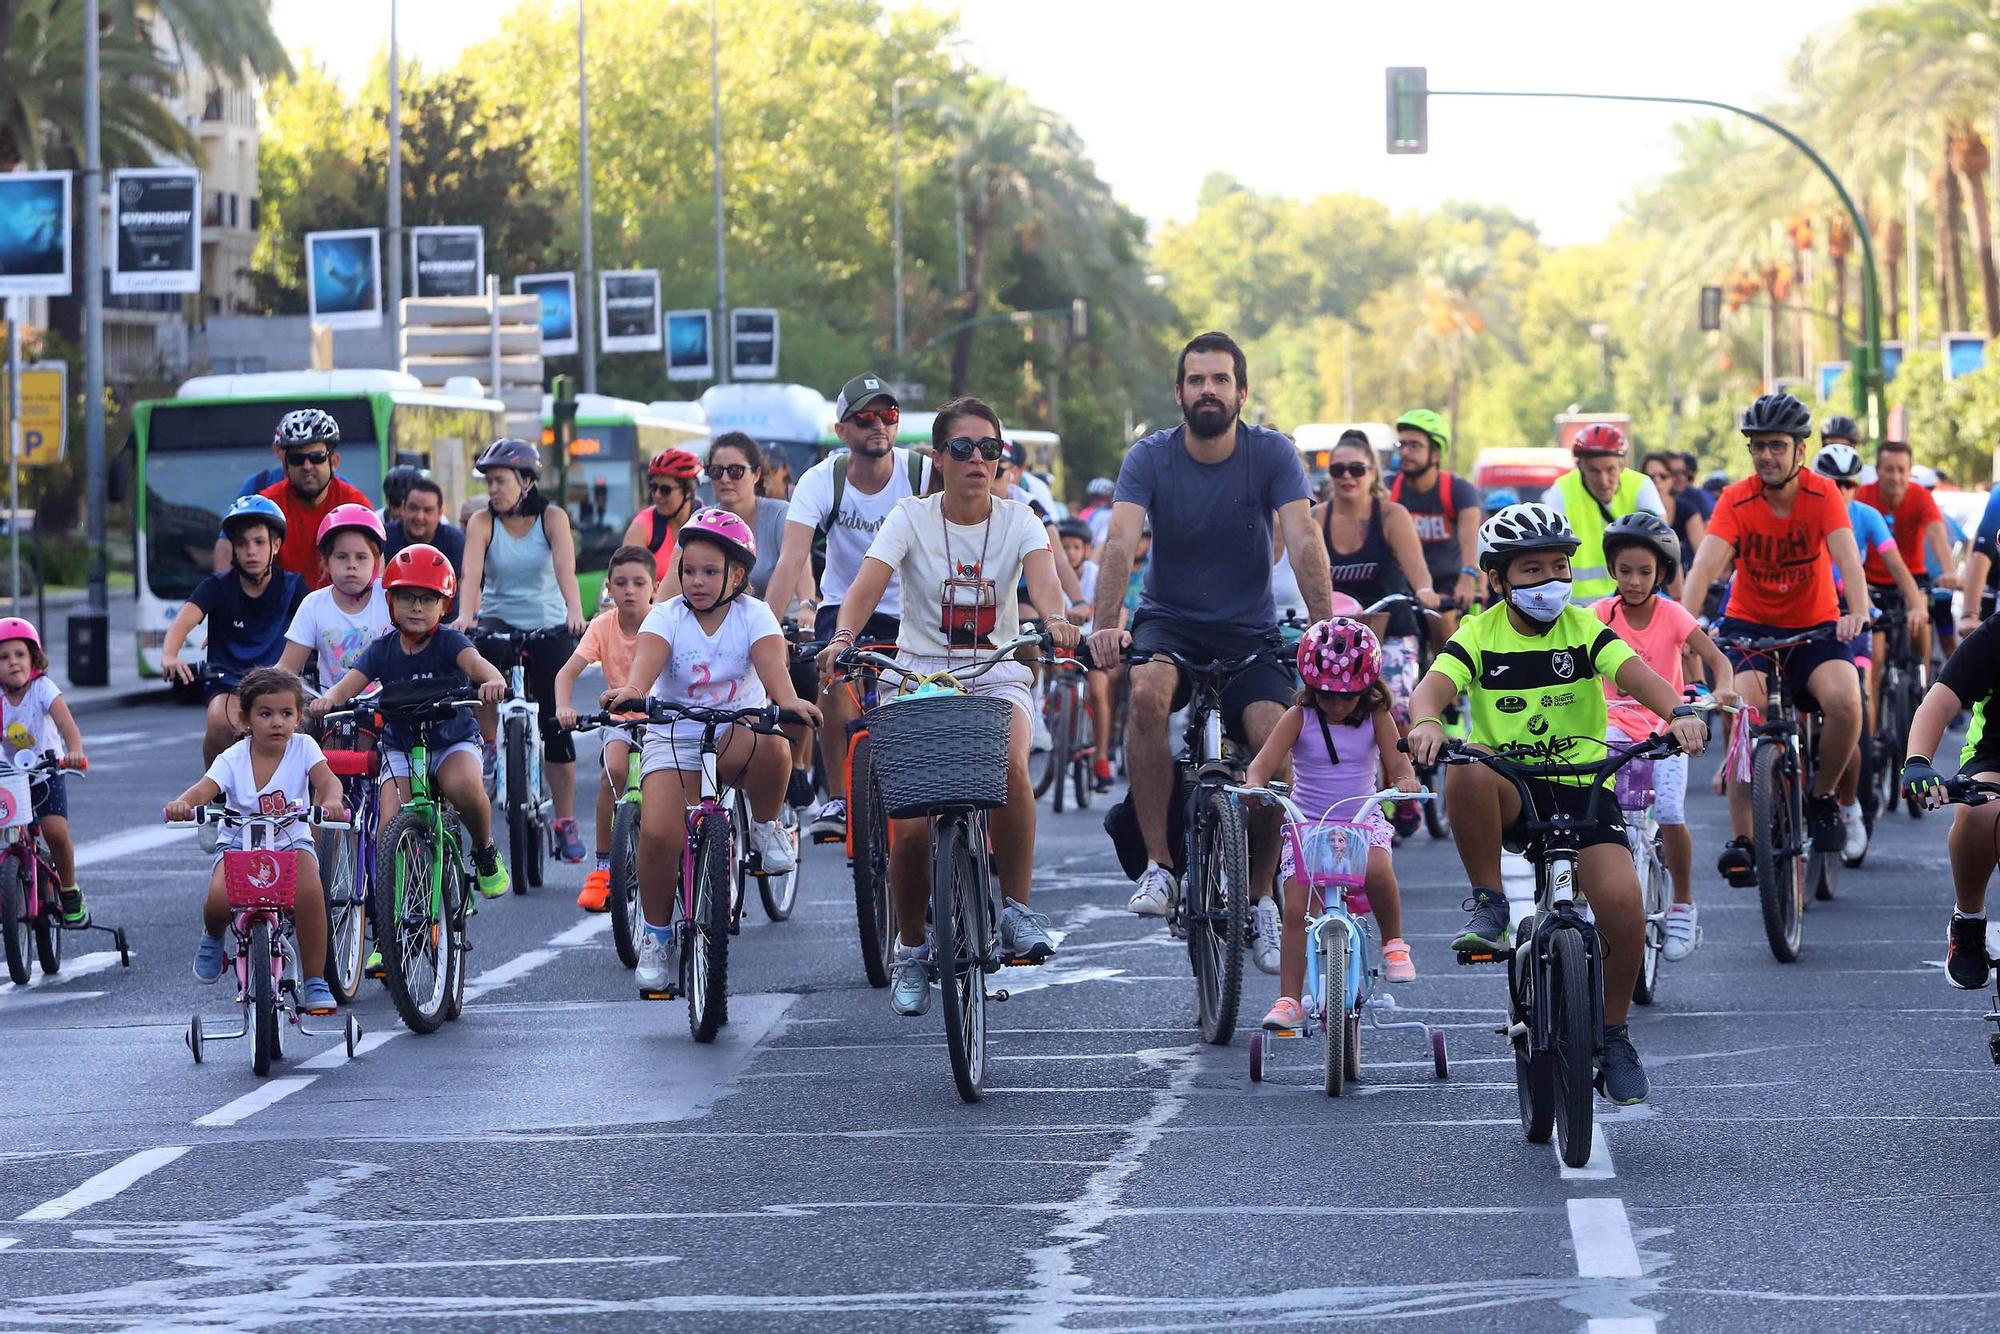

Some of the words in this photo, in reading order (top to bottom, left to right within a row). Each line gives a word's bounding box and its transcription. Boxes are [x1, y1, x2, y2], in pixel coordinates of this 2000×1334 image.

[120, 210, 192, 226] SYMPHONY
[24, 429, 44, 456] P
[258, 789, 287, 815] BE
